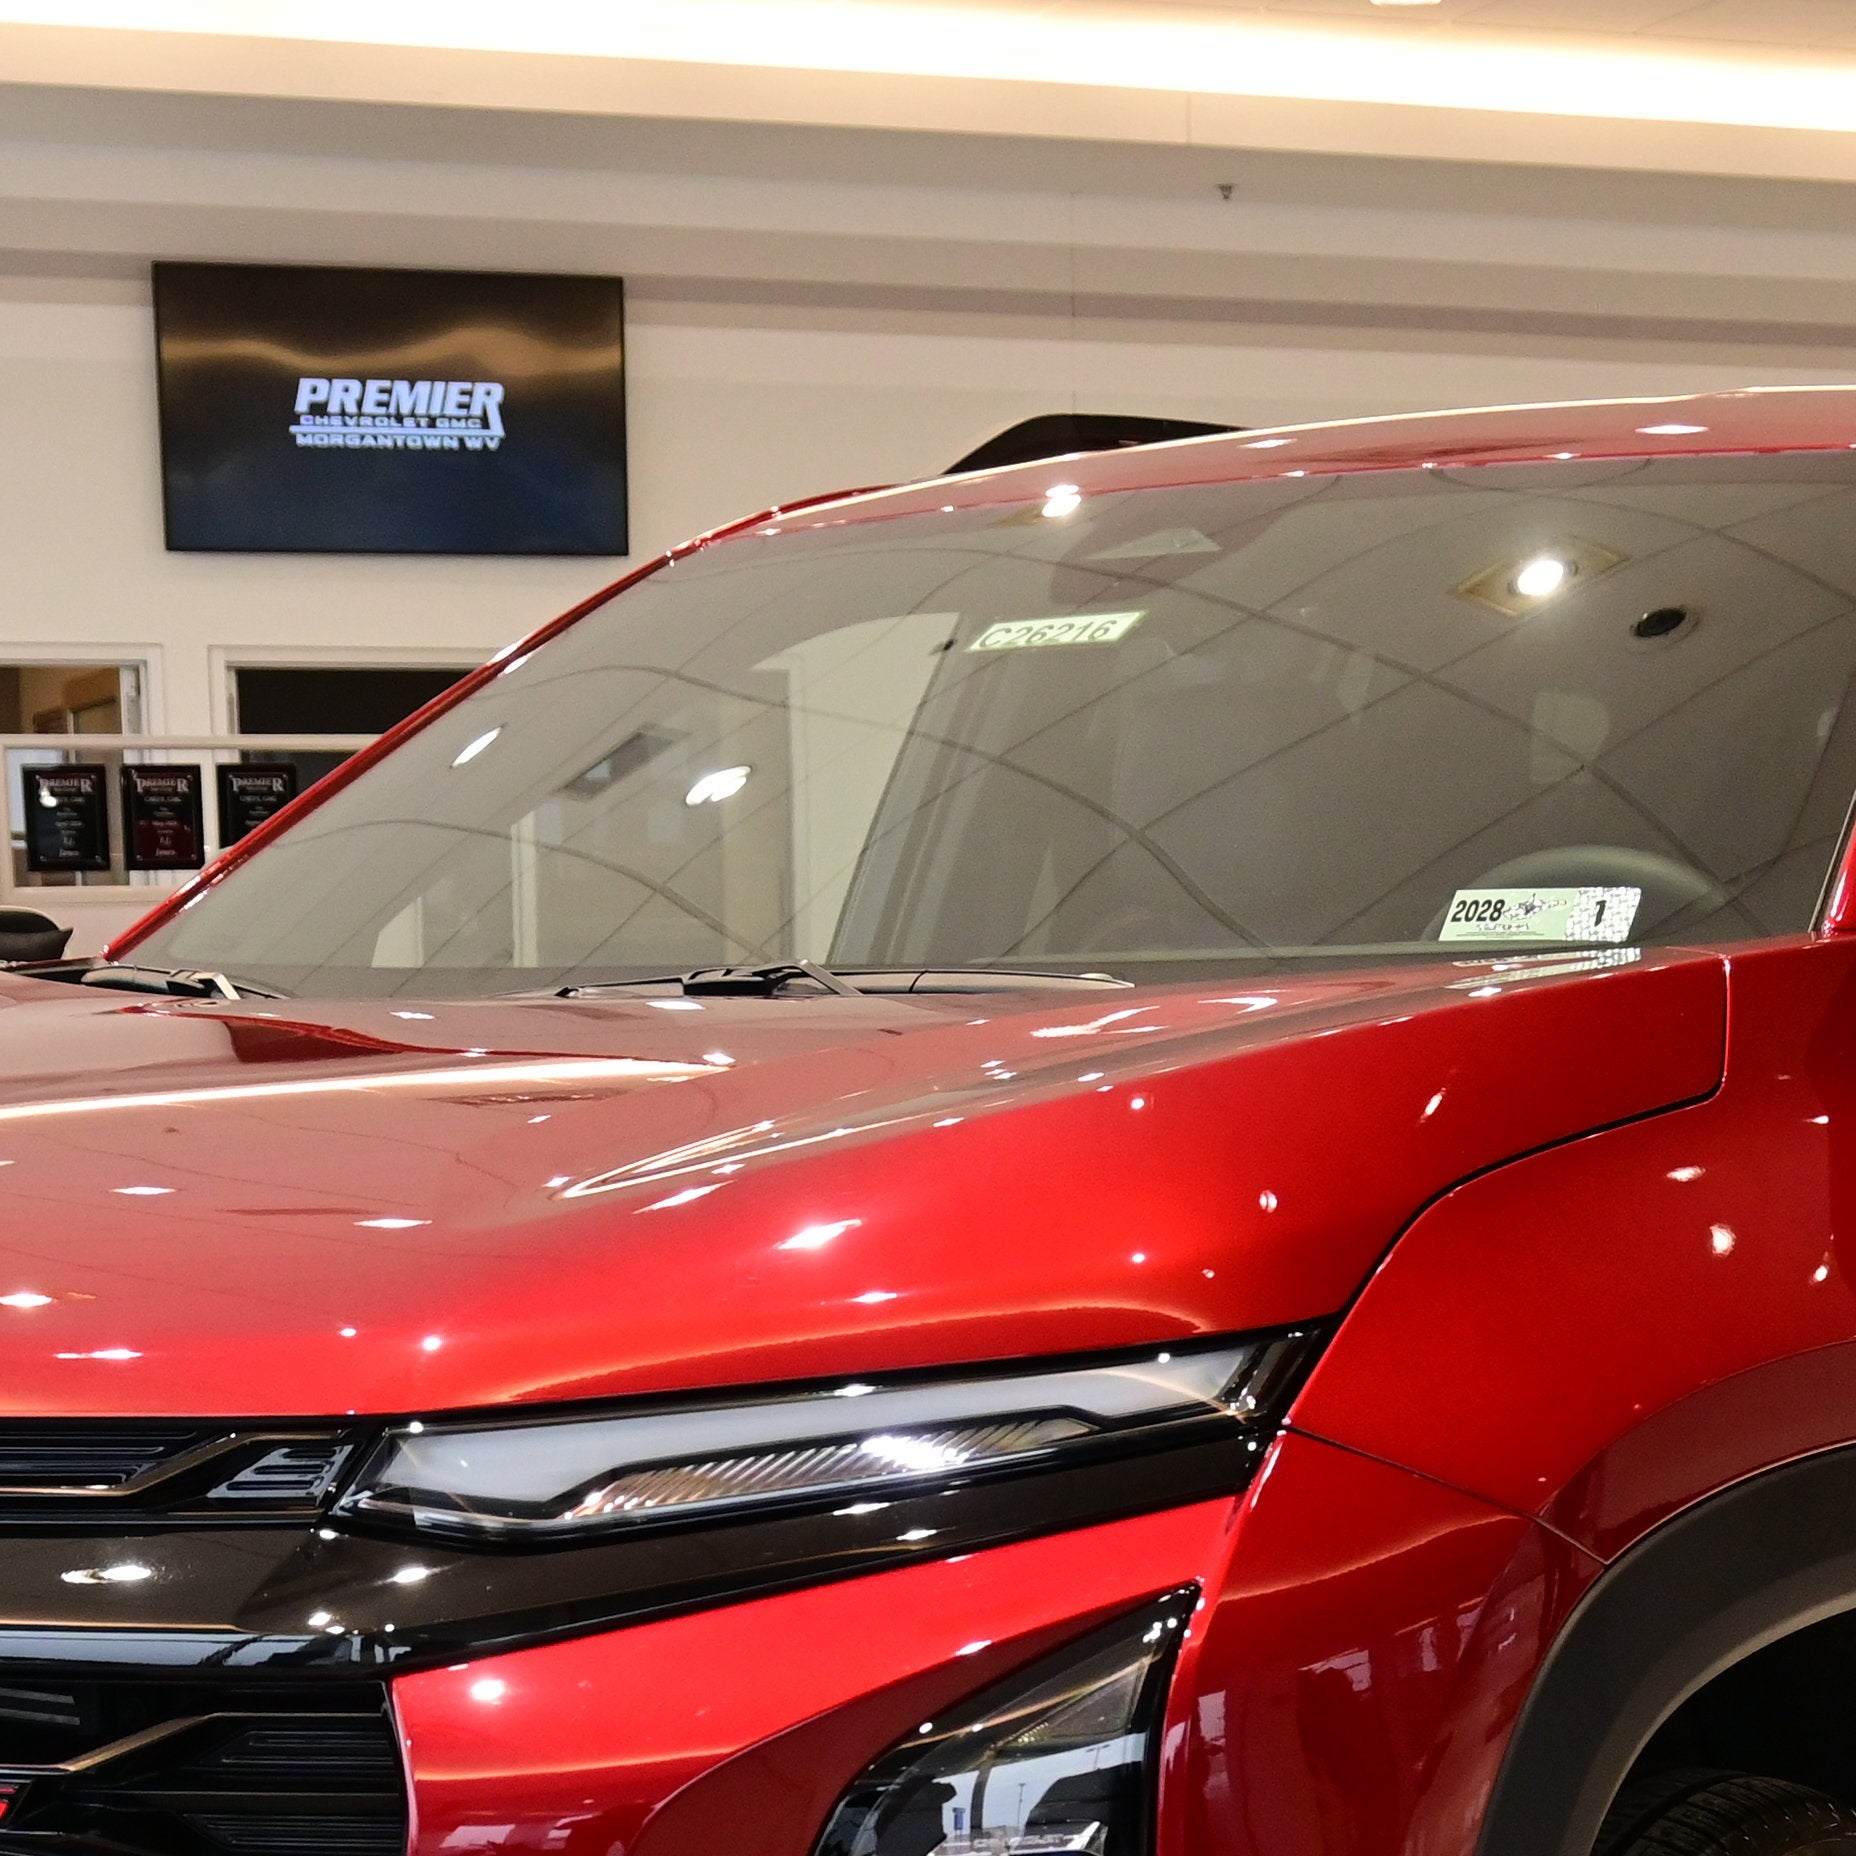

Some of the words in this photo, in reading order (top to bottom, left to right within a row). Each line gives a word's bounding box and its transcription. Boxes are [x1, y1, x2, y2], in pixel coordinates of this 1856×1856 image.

[295, 378, 505, 430] PREMIER
[300, 414, 429, 428] CHEVROLET
[435, 417, 483, 429] GMC
[296, 433, 460, 451] MORGANTOWN
[463, 436, 501, 451] WV
[979, 619, 1118, 648] C26216
[1451, 899, 1505, 923] 2028
[1594, 899, 1607, 928] 1
